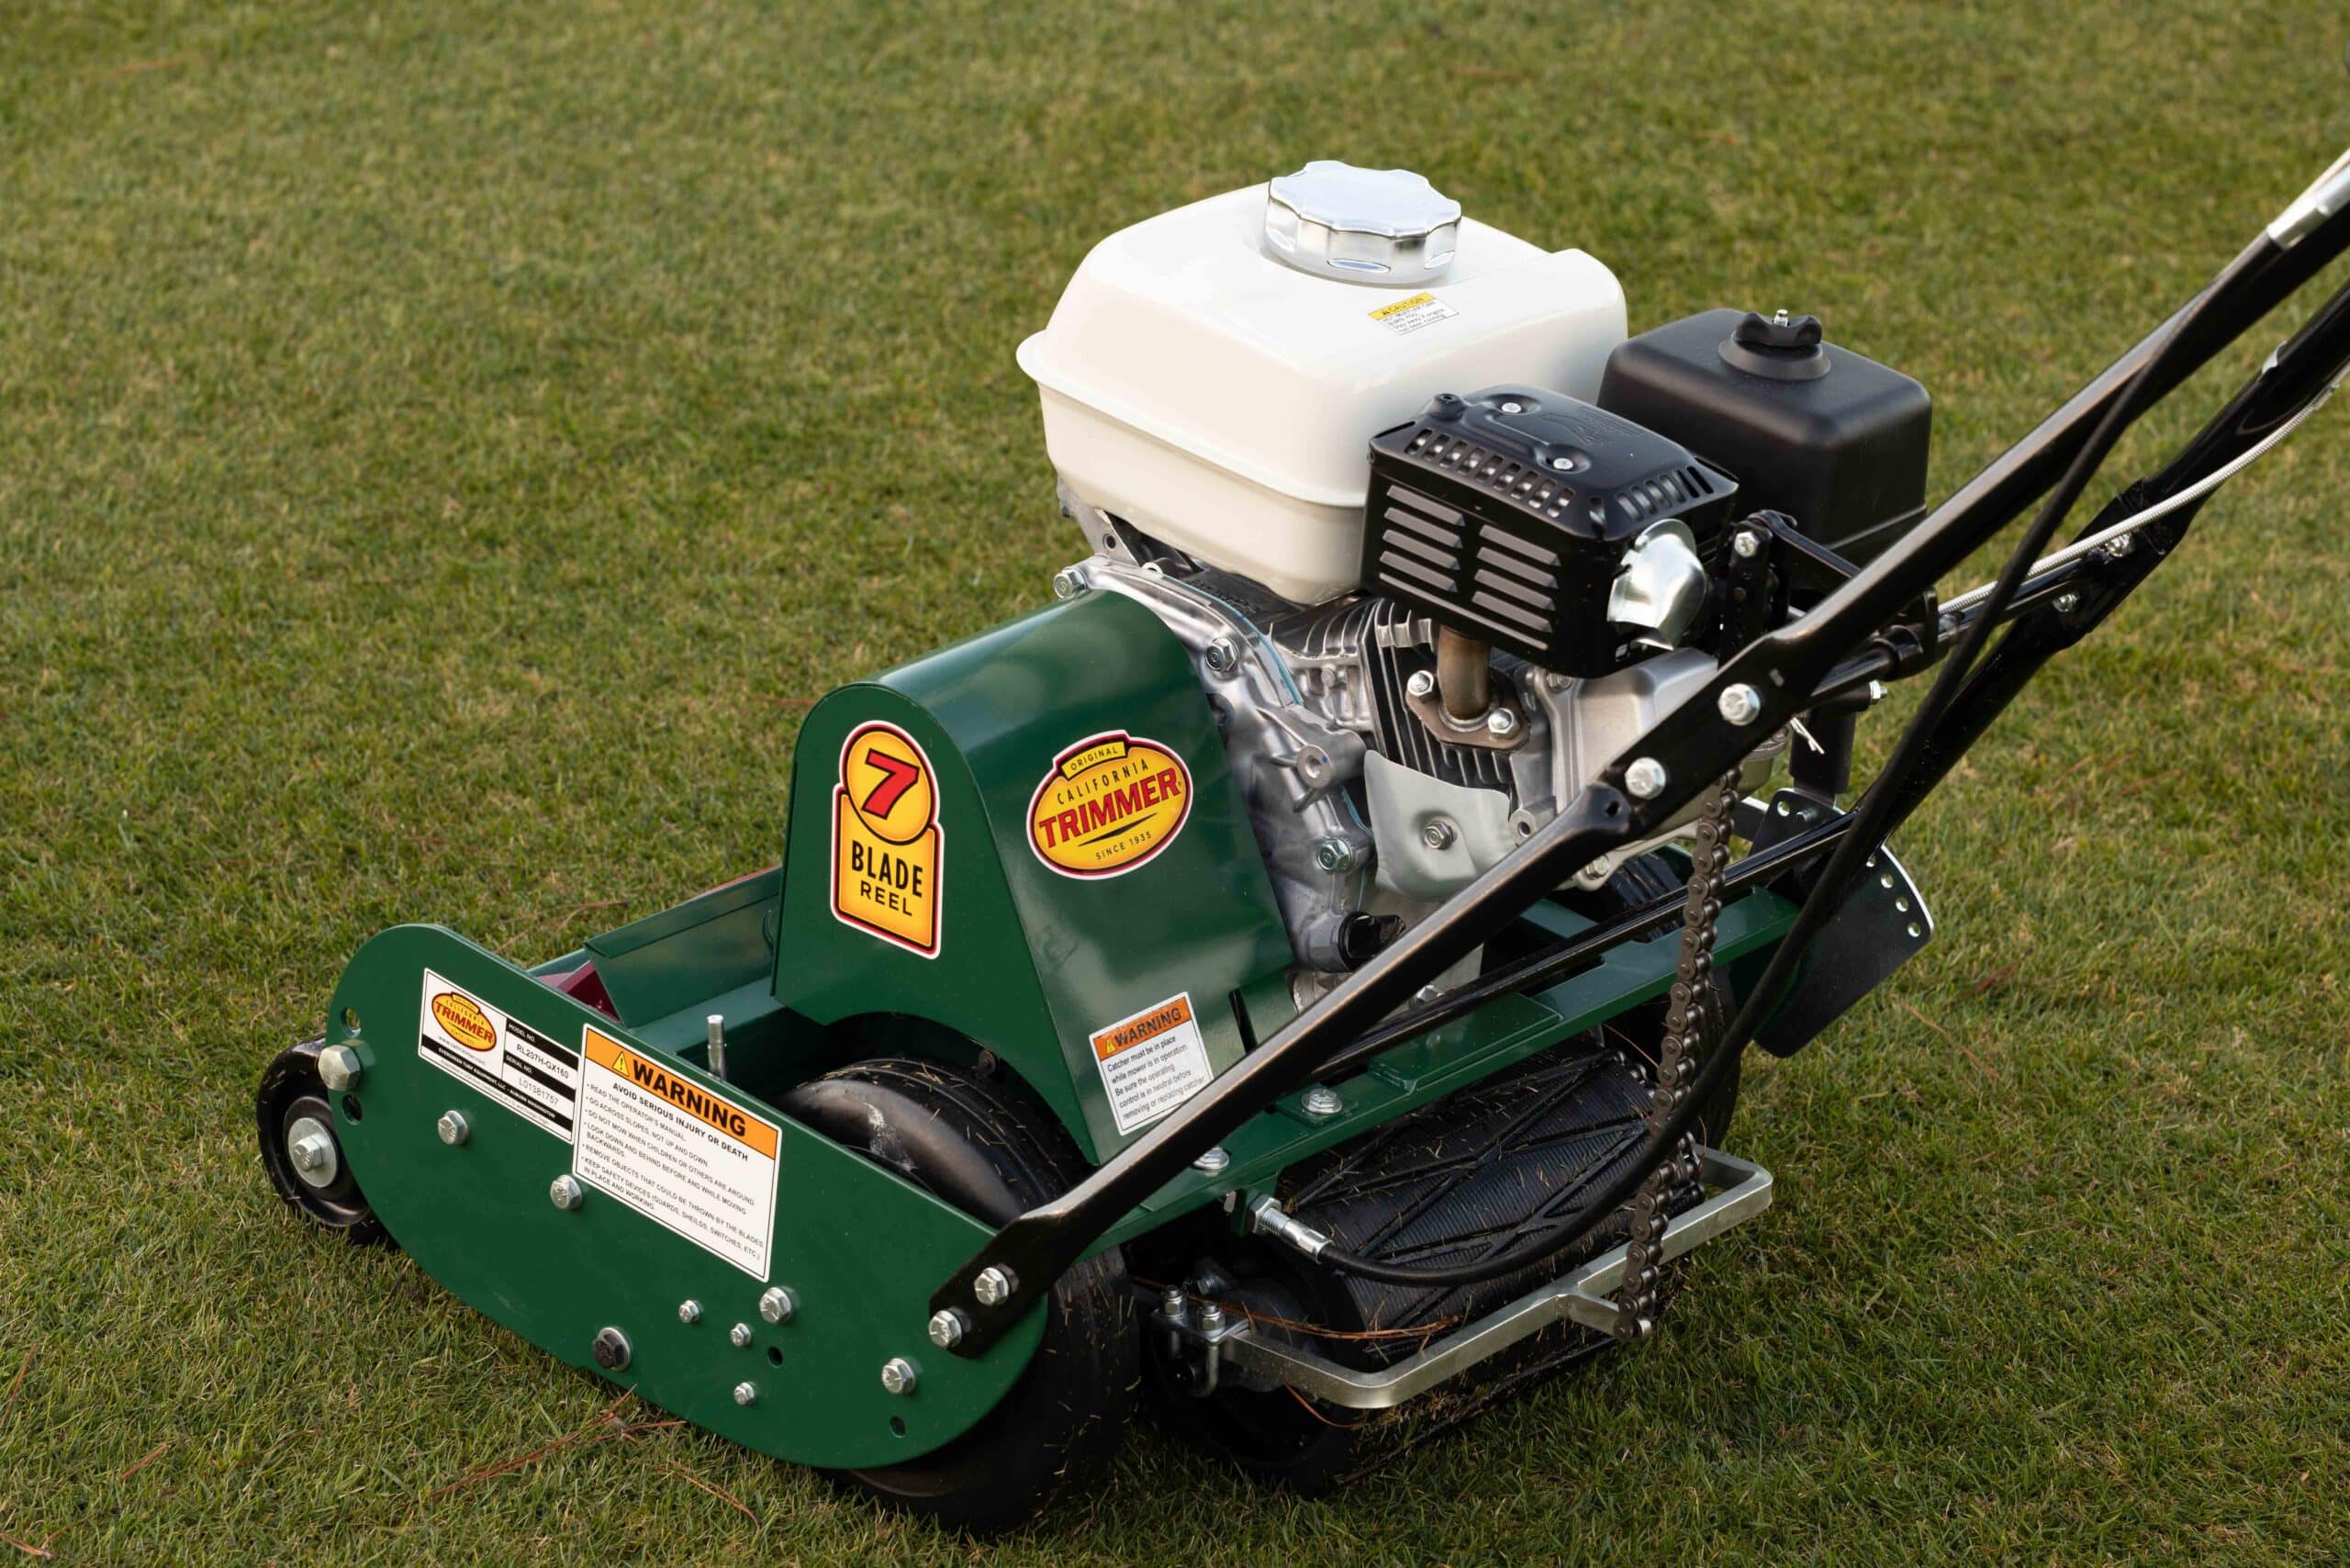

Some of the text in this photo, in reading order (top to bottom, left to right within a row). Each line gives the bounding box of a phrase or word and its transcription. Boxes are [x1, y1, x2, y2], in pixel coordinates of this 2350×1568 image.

[1070, 746, 1118, 771] ORIGINAL
[861, 748, 920, 821] 7
[1058, 758, 1149, 805] CALIFORNIA
[1039, 767, 1181, 848] TRIMMER
[1096, 831, 1151, 859] SINCE 1935
[852, 840, 923, 898] BLADE
[860, 880, 912, 916] REEL
[435, 1000, 493, 1044] TRIMMER
[508, 1022, 535, 1043] MODEL NO.
[1114, 1008, 1182, 1046] WARNING
[506, 1053, 532, 1074] SERIAL NO.
[1107, 1057, 1130, 1072] Catcher
[1130, 1049, 1146, 1061] must
[1146, 1046, 1153, 1055] be
[1160, 1035, 1177, 1048] place
[1112, 1072, 1126, 1083] while
[1127, 1064, 1147, 1077] mower
[632, 1058, 746, 1138] WARNING
[1115, 1063, 1176, 1096] Be sure the operating
[1119, 1093, 1139, 1108] control
[1153, 1078, 1173, 1092] neutral
[1173, 1069, 1191, 1082] before
[589, 1096, 599, 1107] GO
[599, 1102, 624, 1121] ACROSS
[652, 1130, 664, 1143] NOT
[666, 1138, 674, 1148] UP
[674, 1143, 688, 1156] AND
[590, 1083, 607, 1098] READ
[608, 1092, 618, 1104] THE
[621, 1100, 658, 1126] OPERATOR'S
[612, 1081, 748, 1161] AVOID SERIOUS INJURY OR DEATH
[1123, 1103, 1150, 1123] removing
[1158, 1086, 1184, 1105] replacing
[587, 1121, 746, 1215] LOOK DOWN AND BEHIND BEFORE AND WHILE MOVING
[588, 1109, 597, 1119] DO
[598, 1114, 610, 1126] NOT
[611, 1122, 626, 1136] MOW
[628, 1131, 645, 1146] WHEN
[646, 1141, 677, 1163] CHILDREN
[677, 1159, 687, 1169] OR
[688, 1164, 712, 1183] OTHERS
[713, 1178, 726, 1191] ARE
[584, 1156, 600, 1170] KEEP
[601, 1165, 624, 1183] SAFETY
[625, 1179, 650, 1199] DEVICES
[586, 1143, 610, 1162] REMOVE
[611, 1158, 639, 1179] OBJECTS
[640, 1173, 655, 1187] THAT
[656, 1182, 677, 1200] COULD
[688, 1201, 714, 1221] THROWN
[715, 1216, 724, 1226] BY
[725, 1222, 736, 1233] THE
[590, 1169, 610, 1185] PLACE
[611, 1181, 624, 1193] AND
